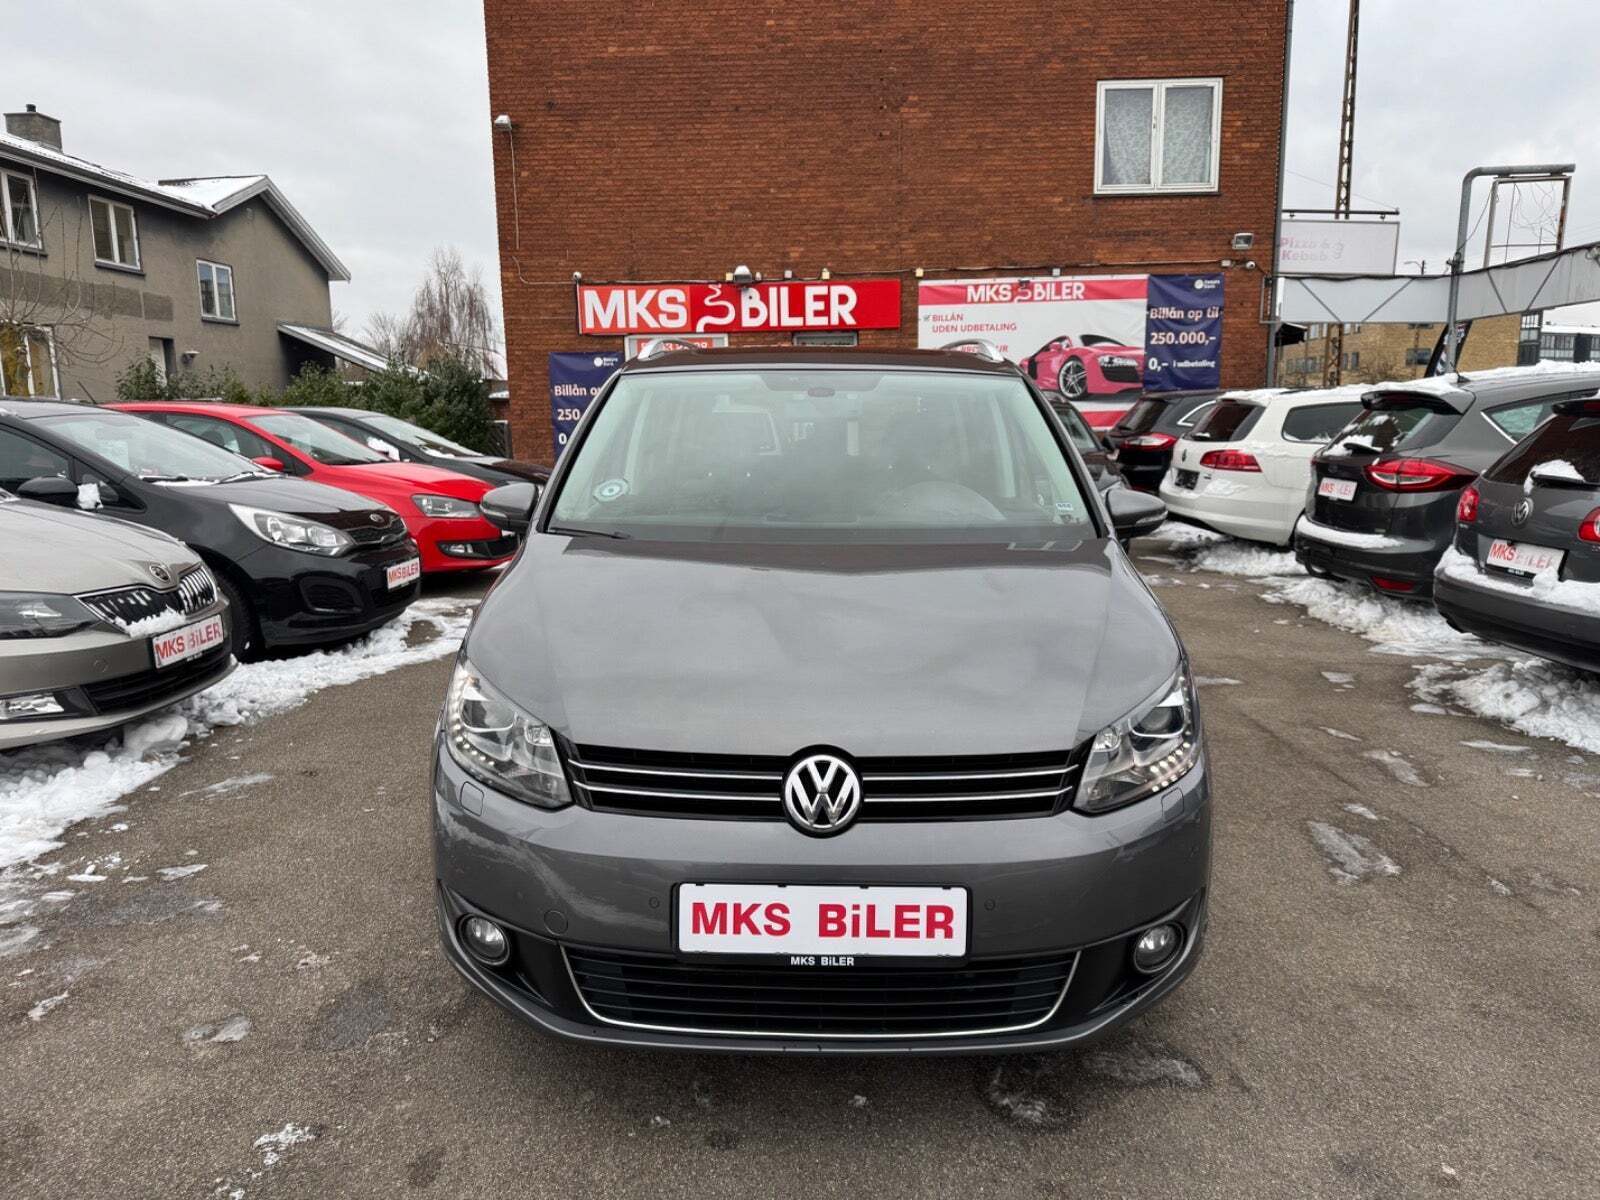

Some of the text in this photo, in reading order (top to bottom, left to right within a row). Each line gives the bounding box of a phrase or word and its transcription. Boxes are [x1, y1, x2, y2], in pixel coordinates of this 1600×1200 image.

[966, 282, 1085, 303] MKS BILER
[583, 285, 858, 329] MKS BILER
[1150, 306, 1219, 322] Billån op til
[932, 311, 964, 322] BILLÅN
[932, 322, 1017, 334] UDEN UDBETALING
[1150, 331, 1216, 346] 250.000,-
[554, 383, 587, 397] Billån
[1490, 543, 1517, 561] MKS
[155, 635, 185, 660] MKS
[691, 902, 955, 939] MKS BiLER
[790, 955, 855, 967] MKS BiLER
